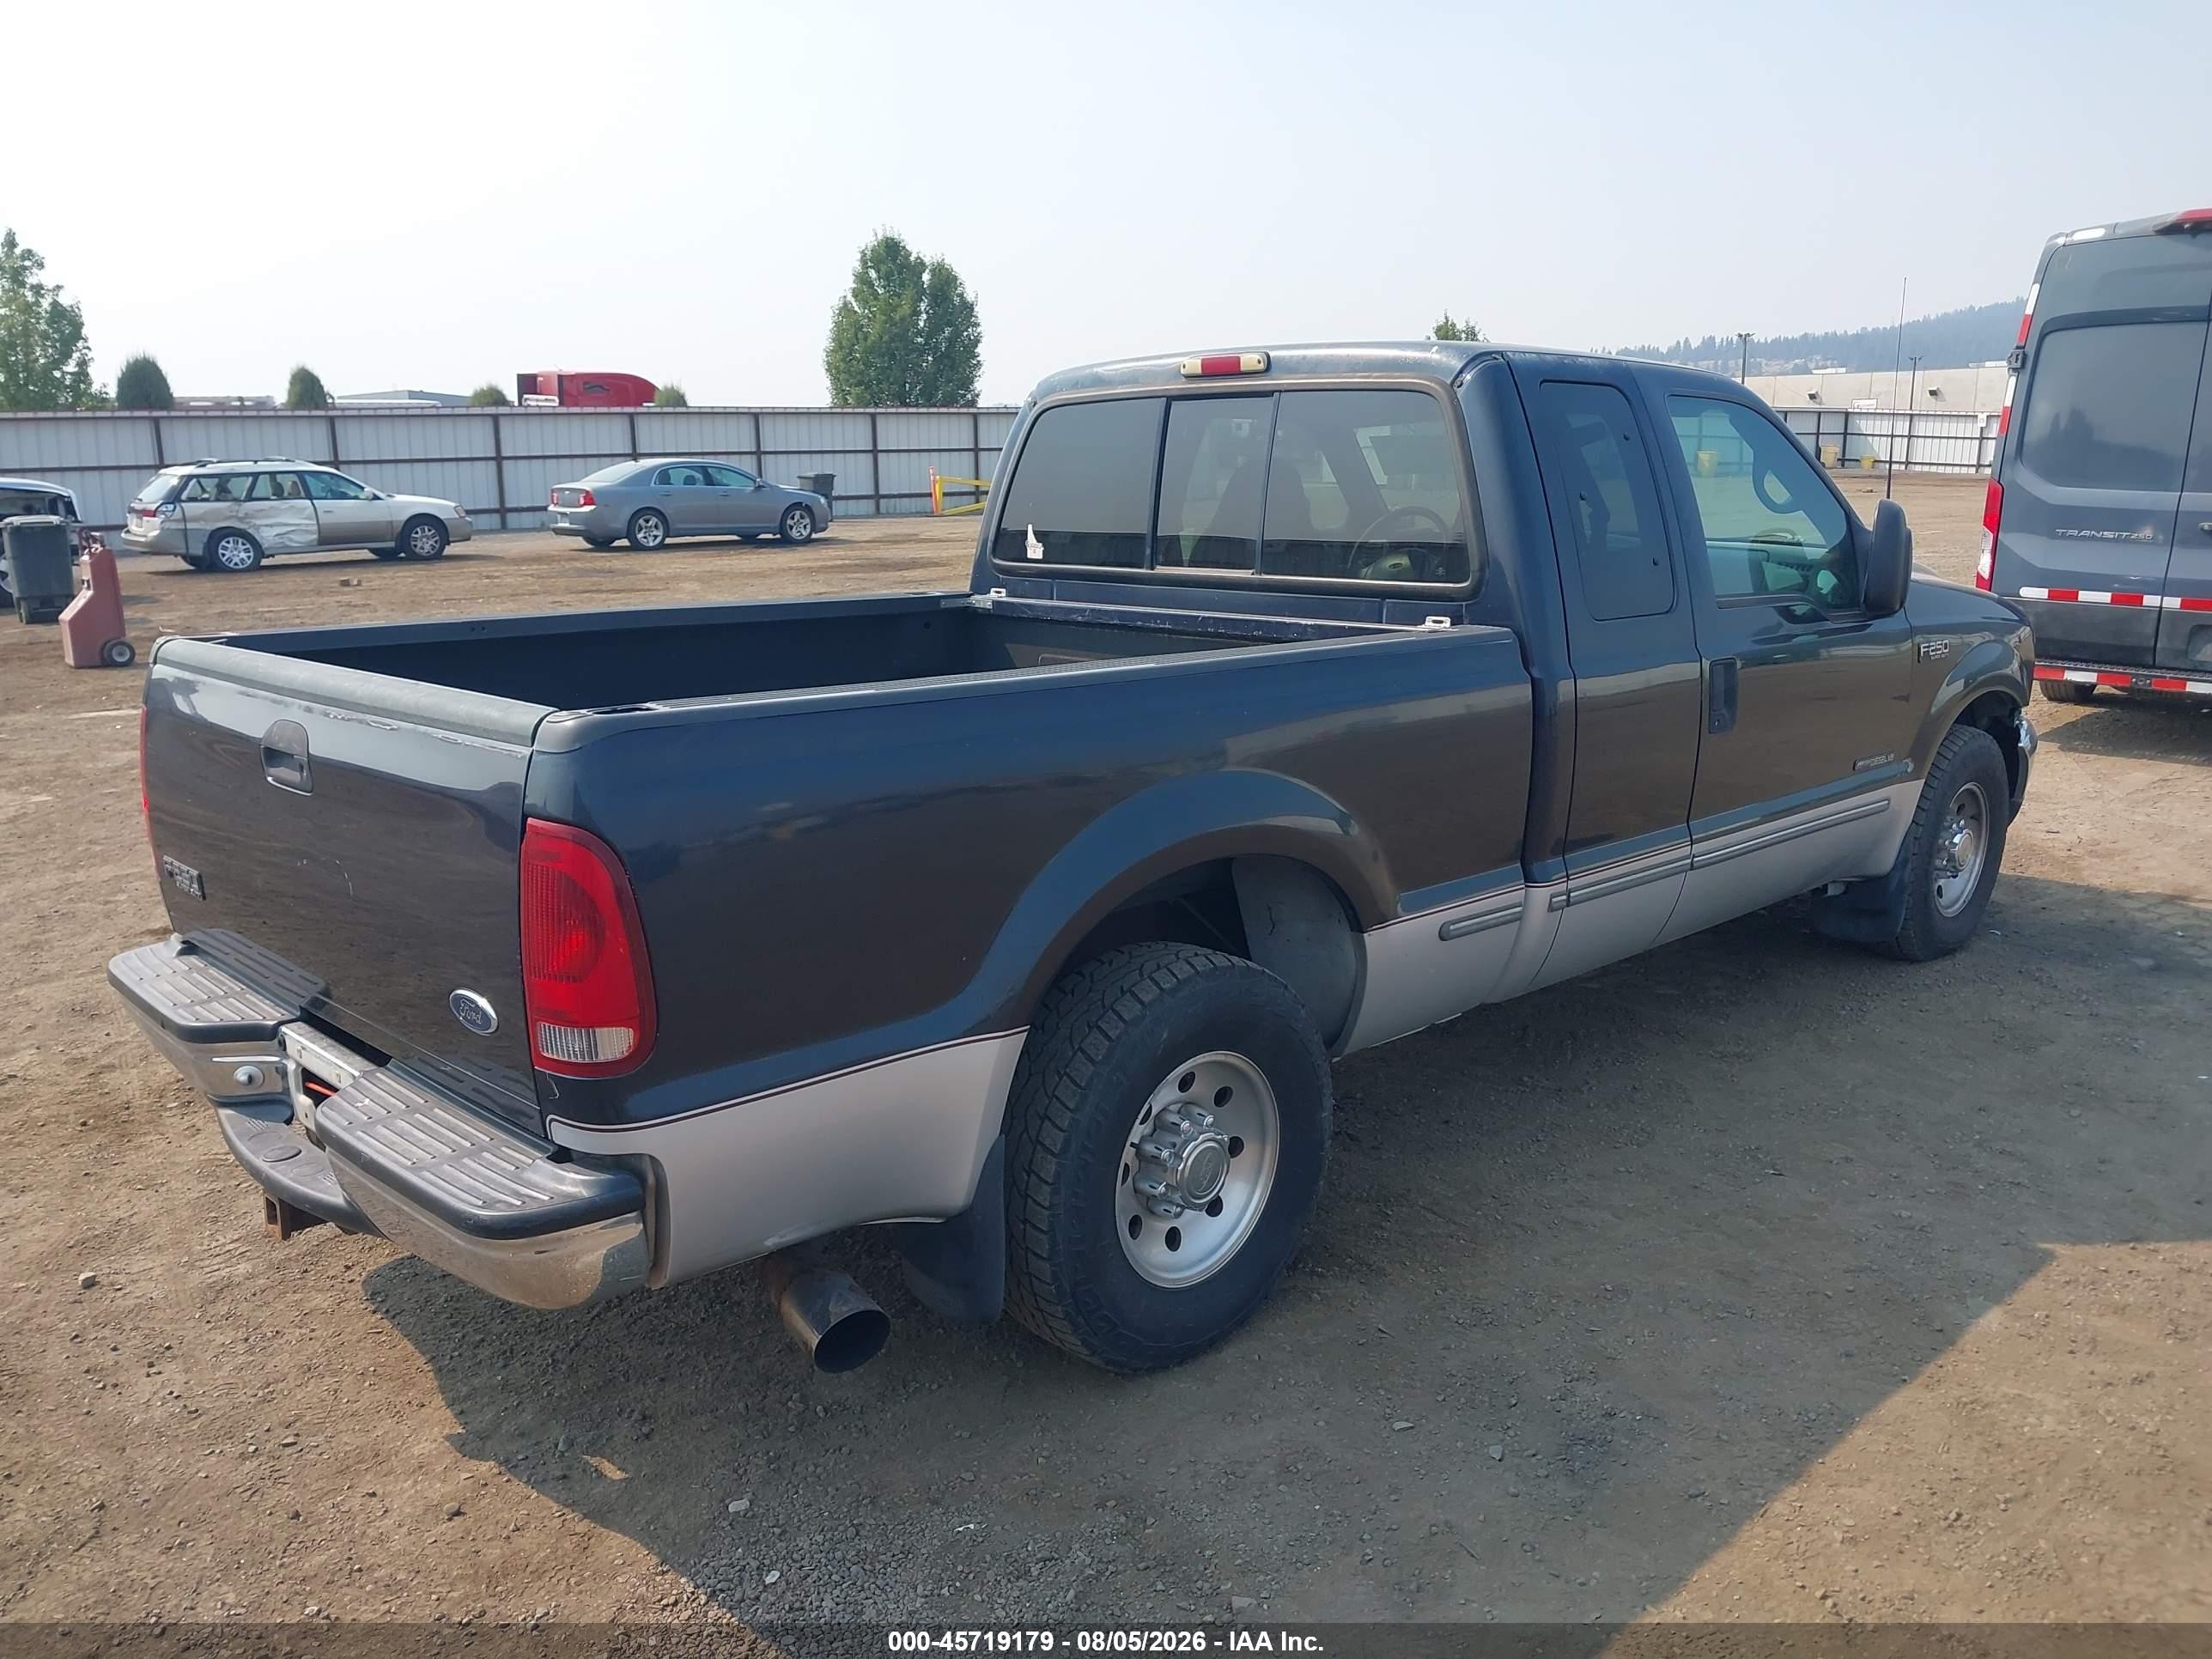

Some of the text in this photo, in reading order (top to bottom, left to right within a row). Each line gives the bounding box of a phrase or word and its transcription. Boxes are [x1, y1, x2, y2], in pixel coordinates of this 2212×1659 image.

[2055, 529, 2130, 539] TRANSIT
[1920, 639, 1949, 657] F250
[459, 998, 483, 1025] Ford
